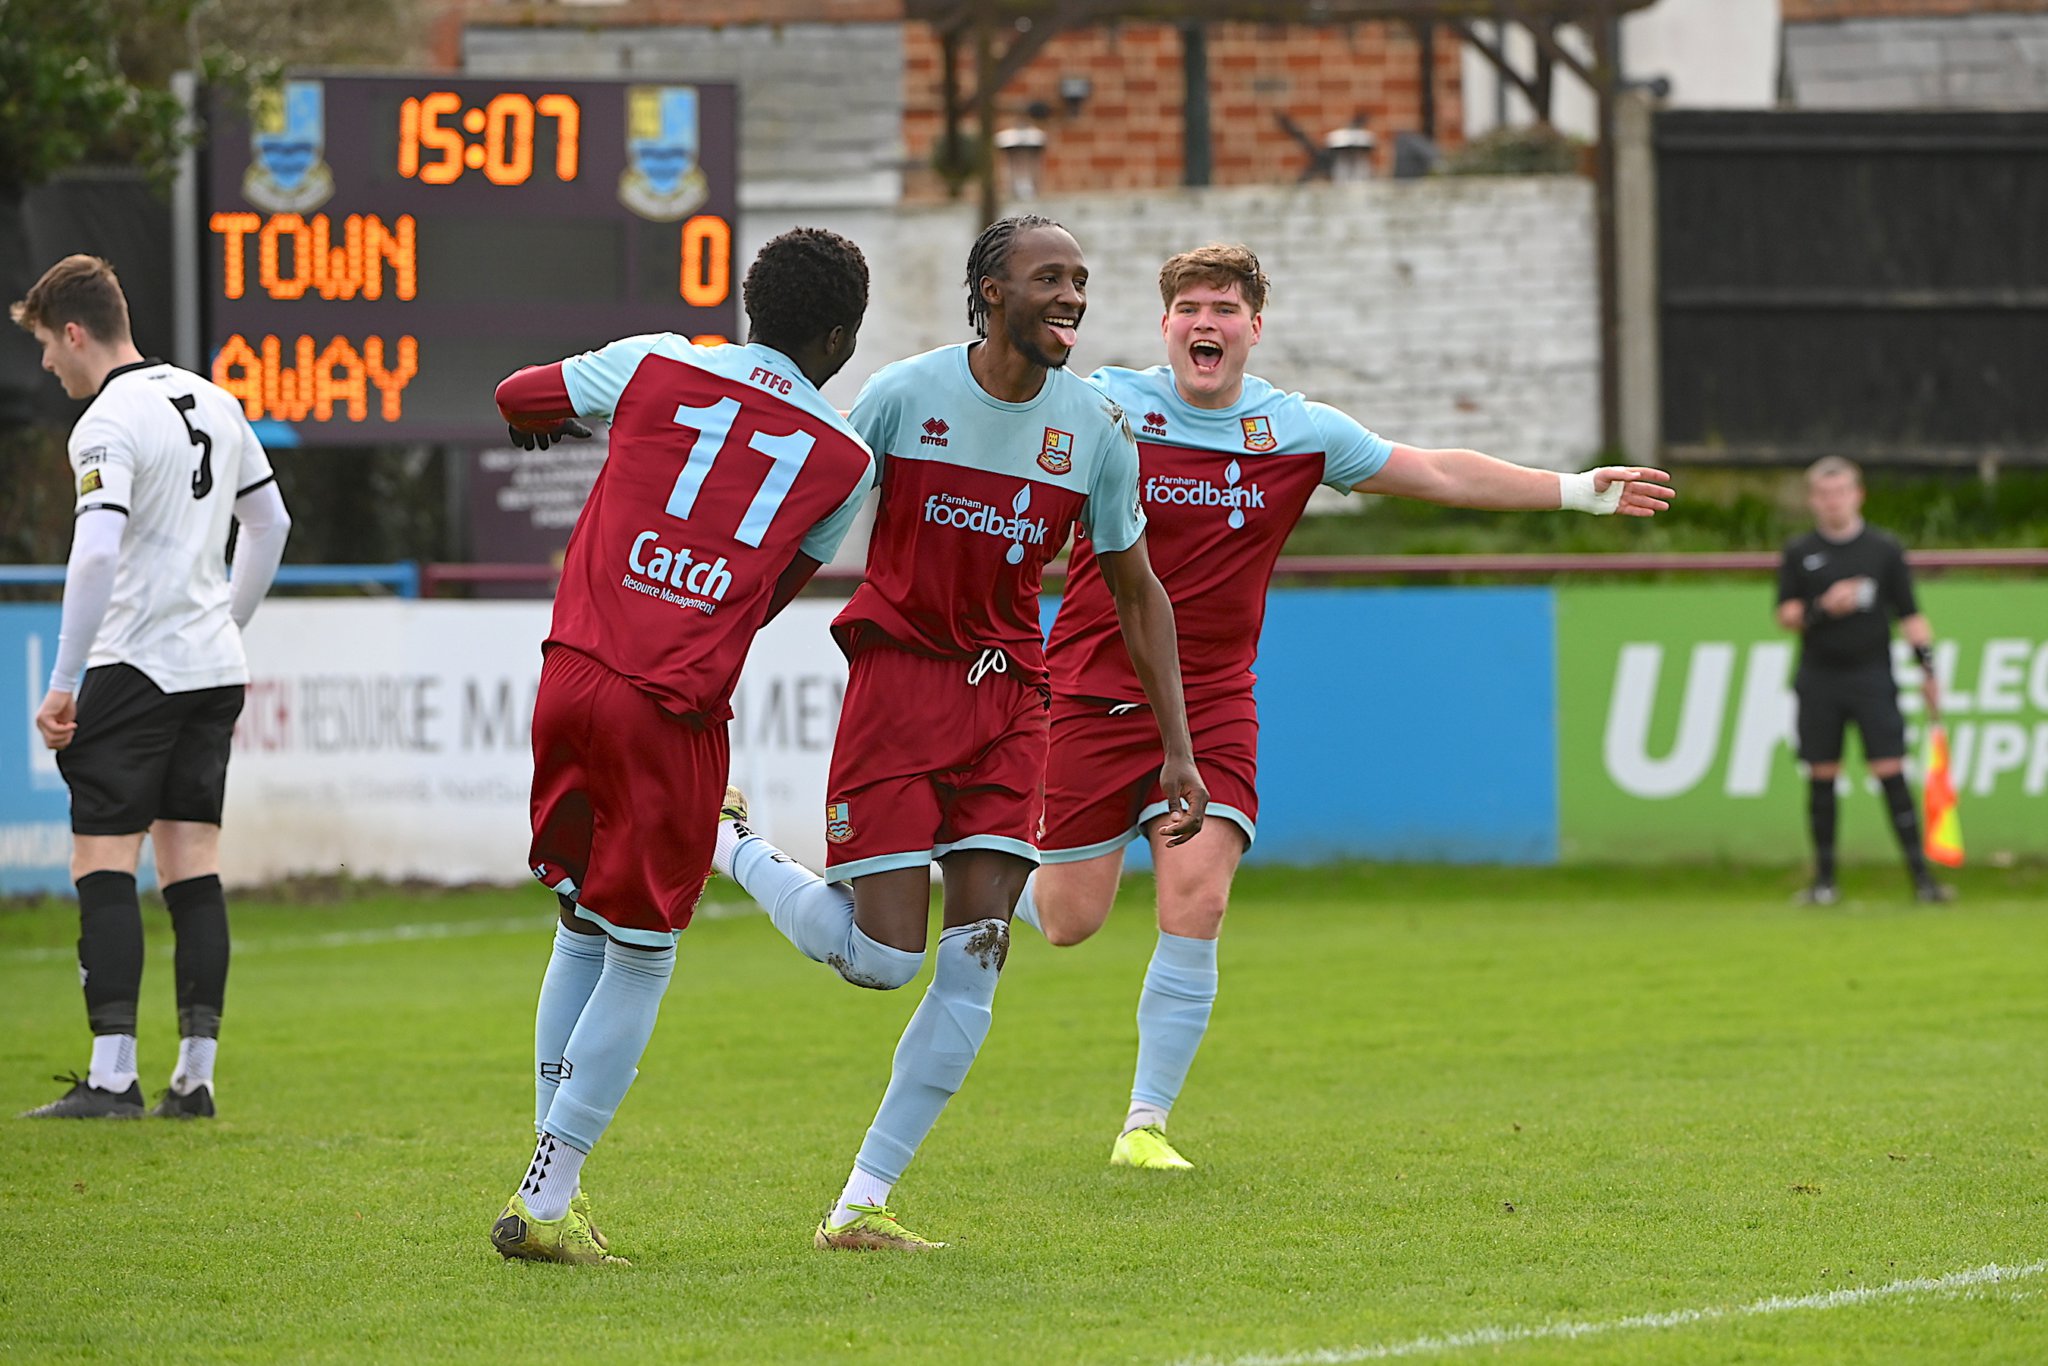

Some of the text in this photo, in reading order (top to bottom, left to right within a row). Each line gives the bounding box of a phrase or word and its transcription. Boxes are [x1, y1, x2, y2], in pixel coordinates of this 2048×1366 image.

[398, 92, 580, 185] 15:07
[209, 212, 731, 307] TOWN 0
[212, 333, 418, 422] AWAY
[749, 366, 793, 395] FTFC
[167, 394, 213, 499] 5
[665, 396, 817, 549] 11
[941, 493, 982, 510] Farnham
[1145, 477, 1266, 509] foodbank
[1159, 475, 1197, 486] Farnham
[924, 495, 1049, 545] foodbank
[621, 574, 716, 616] Resource Management
[628, 531, 733, 601] Catch
